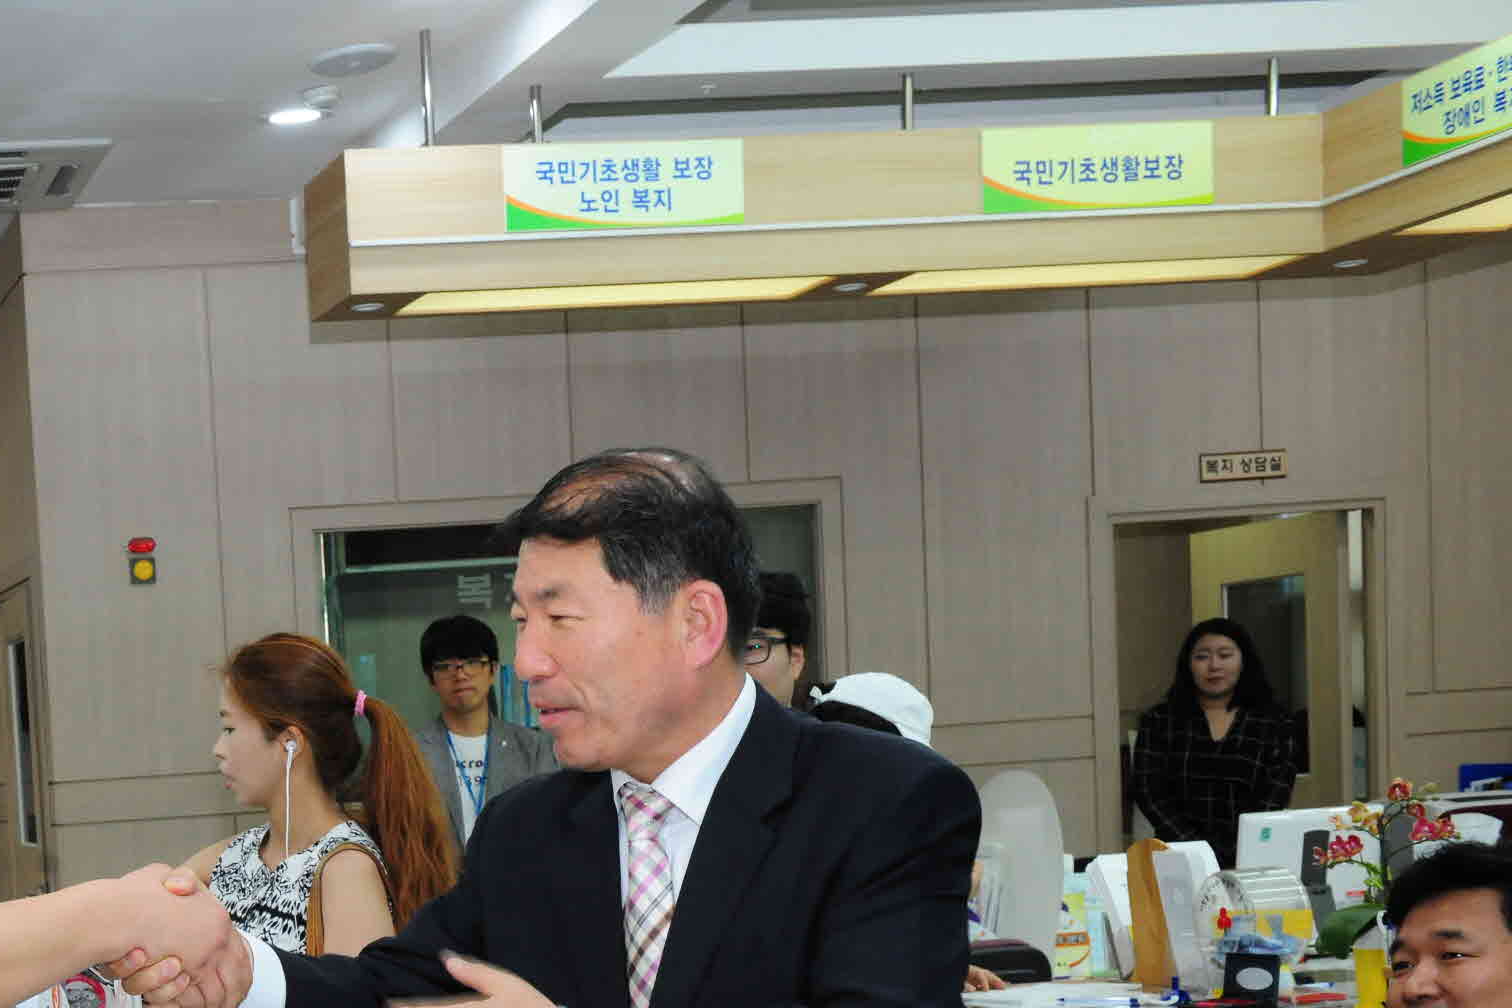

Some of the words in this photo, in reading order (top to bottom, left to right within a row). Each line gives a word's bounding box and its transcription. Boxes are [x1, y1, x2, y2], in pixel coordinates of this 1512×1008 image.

[1410, 81, 1445, 112] 저소득
[1444, 96, 1485, 135] 장애인
[1493, 86, 1512, 112] 복
[535, 156, 661, 185] 국민기초생활
[672, 155, 713, 181] 보장
[1013, 153, 1183, 186] 국민기초생활보장
[578, 188, 620, 213] 노인
[631, 187, 672, 212] 복지
[1207, 458, 1233, 475] 복지
[1240, 456, 1281, 473] 상담실
